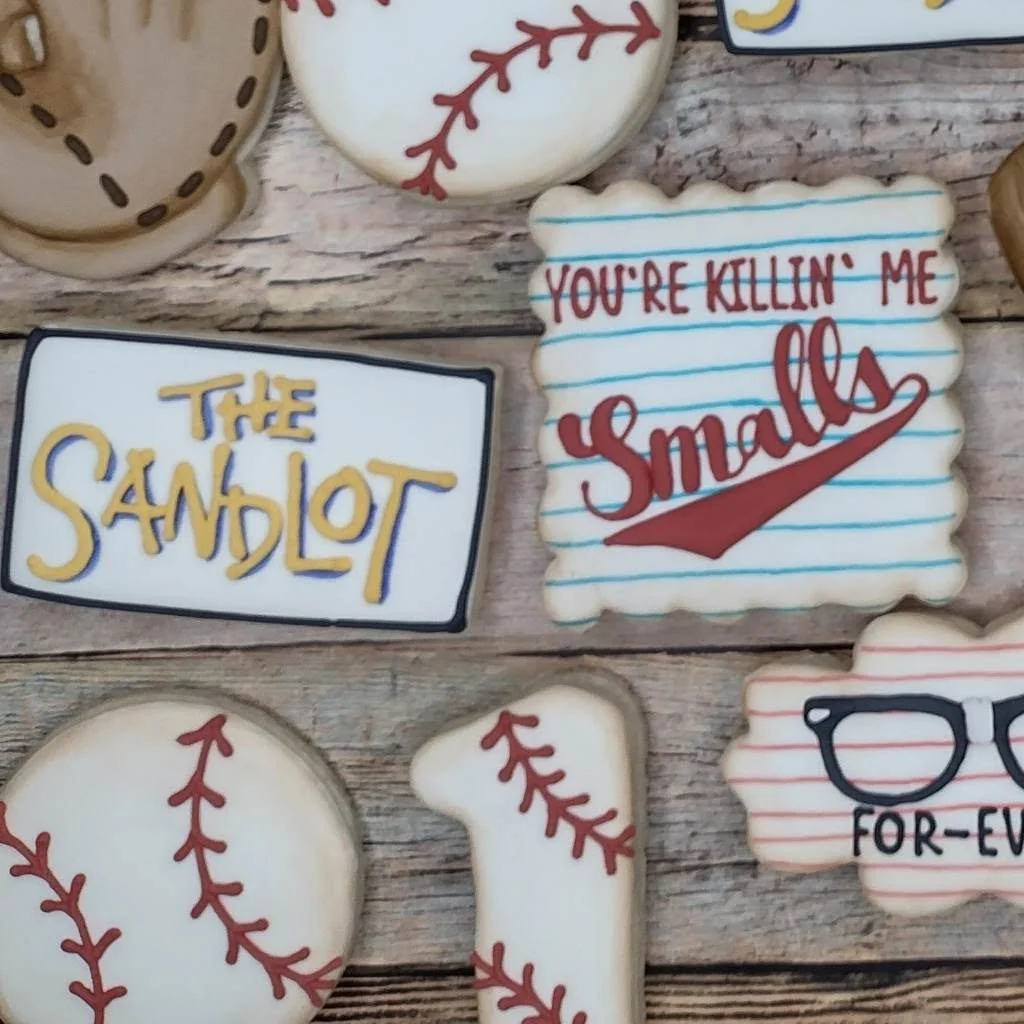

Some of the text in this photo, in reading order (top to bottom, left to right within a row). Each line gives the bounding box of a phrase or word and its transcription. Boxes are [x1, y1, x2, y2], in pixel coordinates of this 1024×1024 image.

[546, 249, 938, 323] YOU'RE KILLIN' ME
[158, 370, 317, 444] THE
[557, 316, 896, 522] Smalls
[27, 423, 458, 604] SANDLOT
